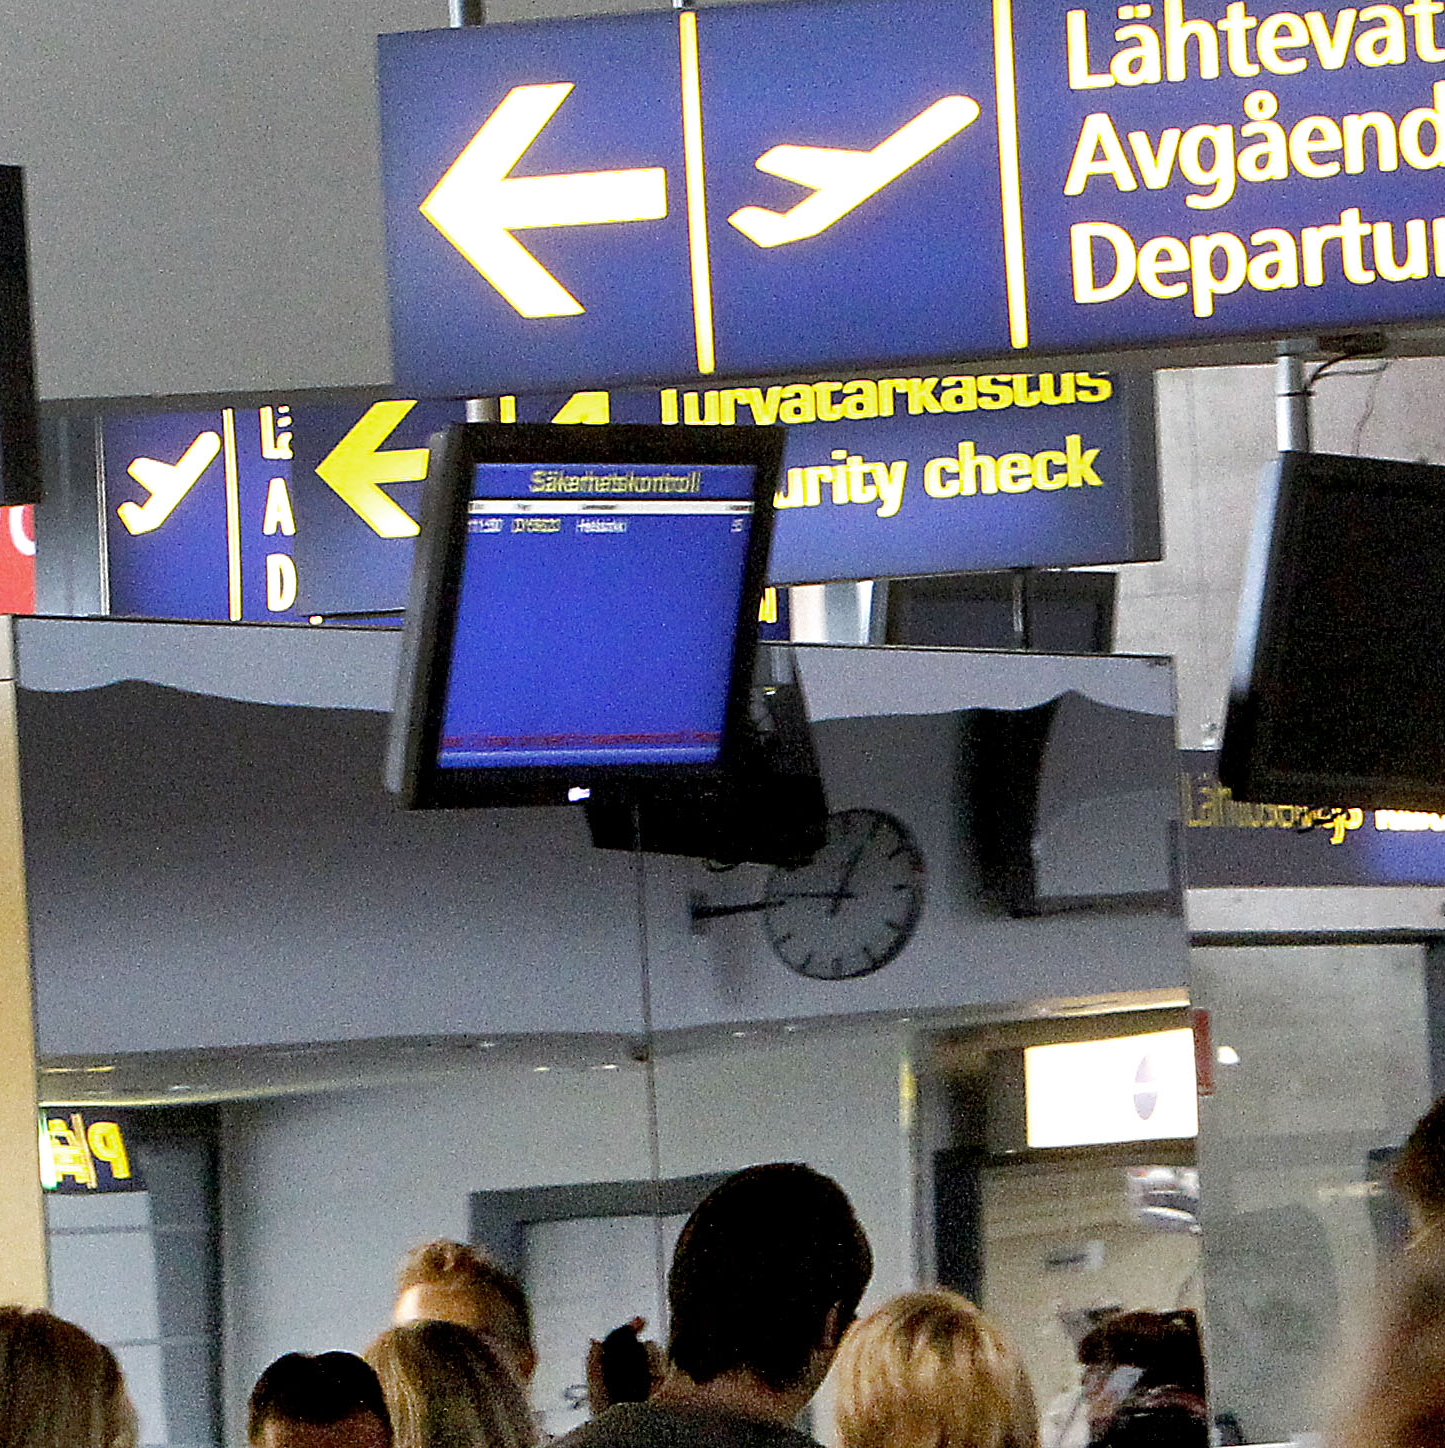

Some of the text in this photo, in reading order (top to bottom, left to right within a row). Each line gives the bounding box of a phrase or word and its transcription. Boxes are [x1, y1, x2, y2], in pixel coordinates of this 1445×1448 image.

[529, 470, 702, 494] Säkerhetskontroll
[773, 434, 1104, 518] urity check
